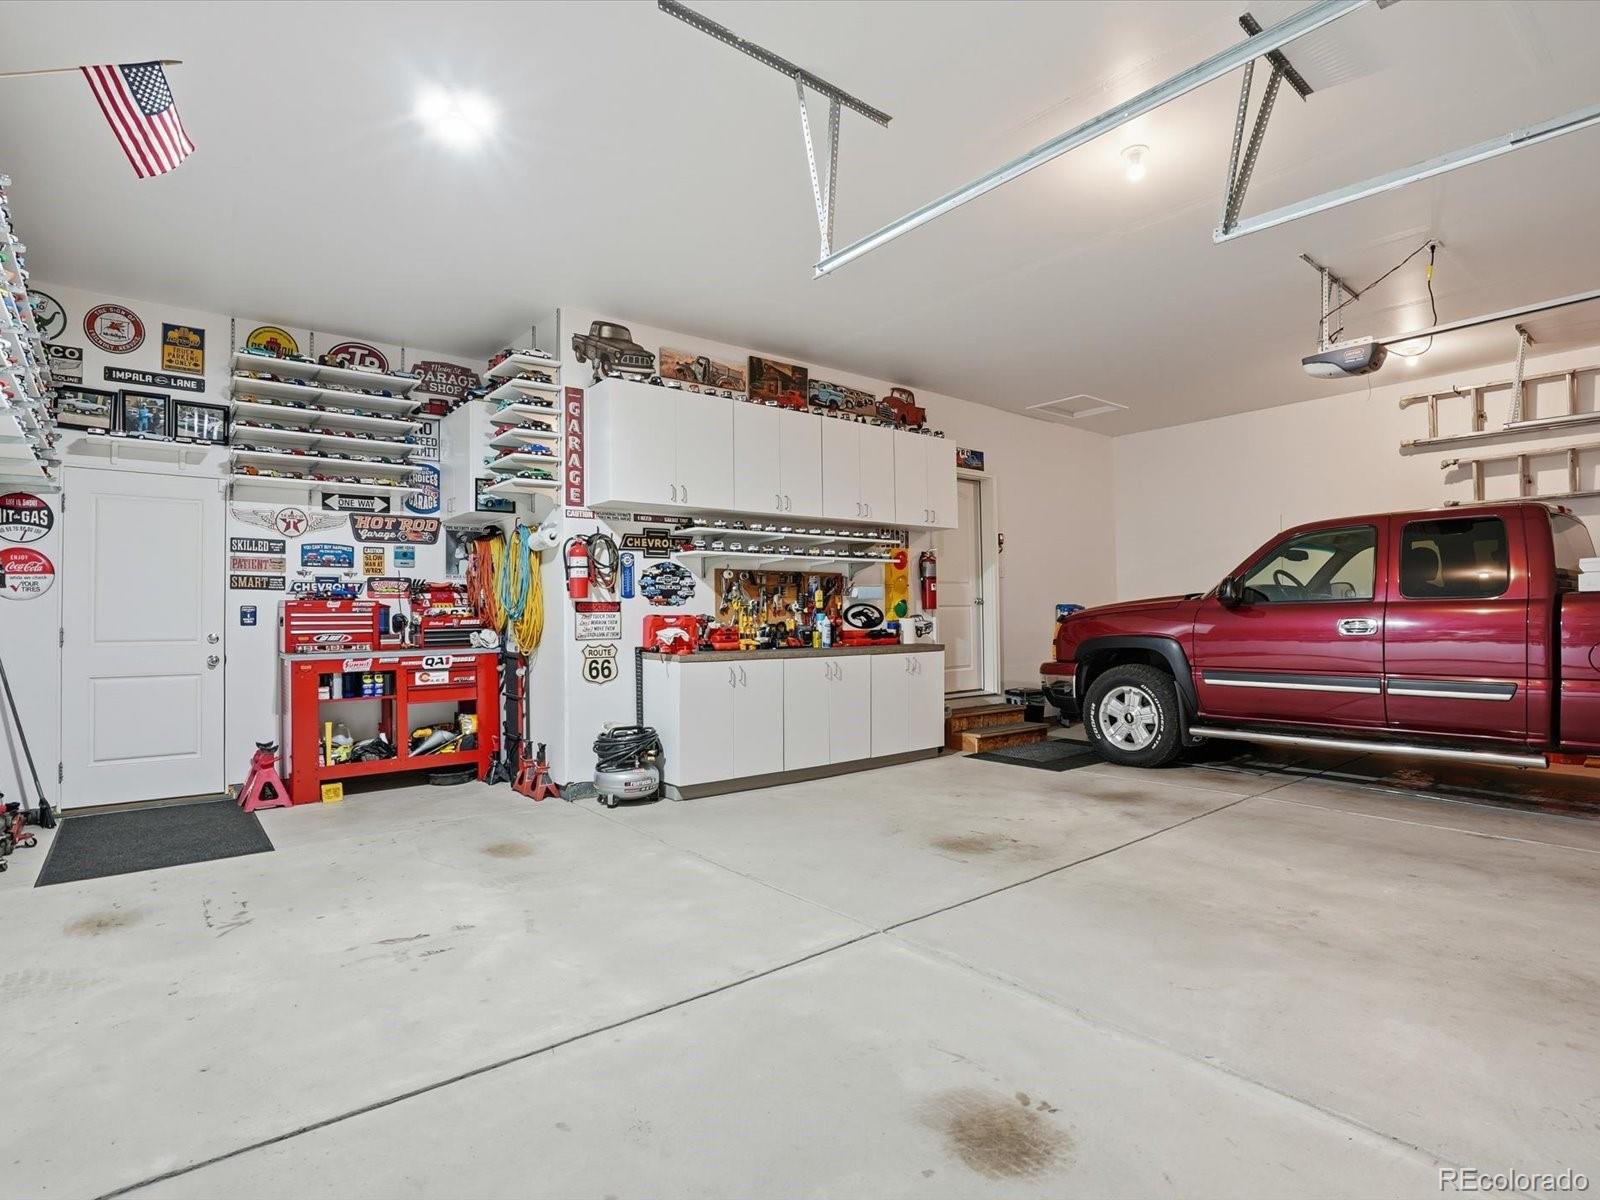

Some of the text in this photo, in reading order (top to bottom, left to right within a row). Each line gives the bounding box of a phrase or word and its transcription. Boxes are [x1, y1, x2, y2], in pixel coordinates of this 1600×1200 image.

[174, 359, 193, 367] ONLY
[112, 369, 153, 383] IMPALA
[170, 379, 198, 389] LANE
[414, 368, 477, 389] GARAGE
[429, 382, 463, 395] SHOP
[567, 400, 582, 503] GARAGE
[338, 499, 375, 508] ONE WAY
[21, 510, 48, 526] GAS
[353, 515, 396, 530] HOT
[398, 518, 438, 532] ROD
[358, 529, 397, 540] Garage
[231, 539, 269, 552] SKILLED
[232, 558, 269, 570] PATIENT
[231, 576, 269, 588] SMART
[588, 649, 612, 657] ROUTE
[424, 656, 450, 667] QA1
[588, 659, 612, 680] 66
